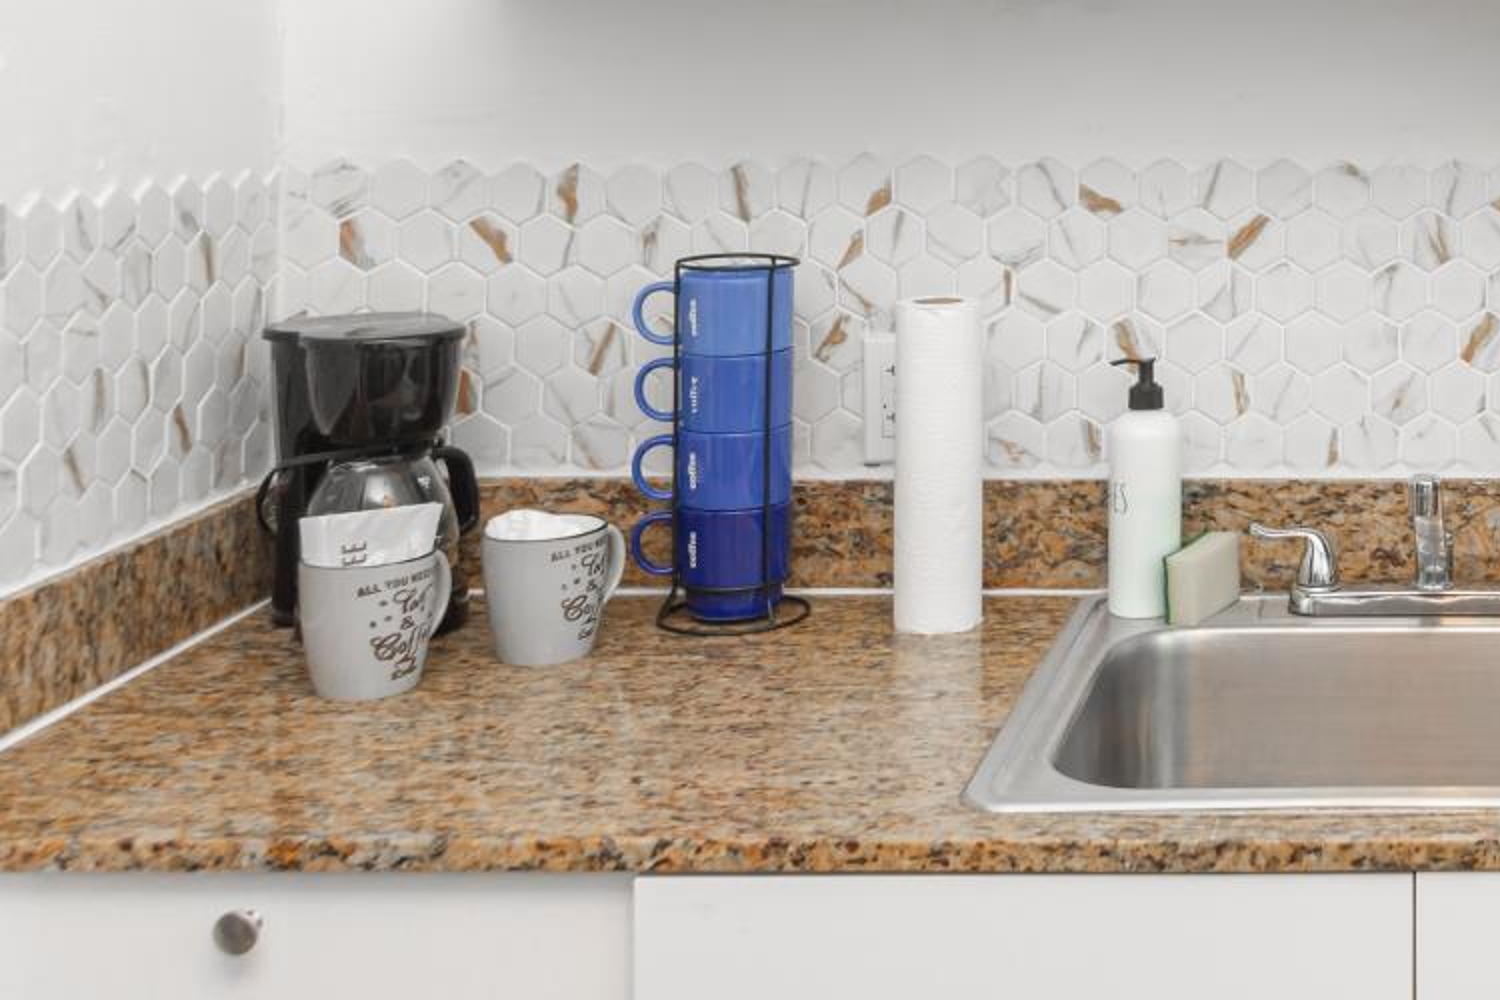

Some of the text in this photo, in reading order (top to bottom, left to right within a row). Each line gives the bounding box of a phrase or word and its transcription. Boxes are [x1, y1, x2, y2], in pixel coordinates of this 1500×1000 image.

[687, 451, 698, 491] coffee
[687, 531, 698, 569] coffee
[357, 583, 382, 598] ALL
[384, 574, 410, 591] YOU
